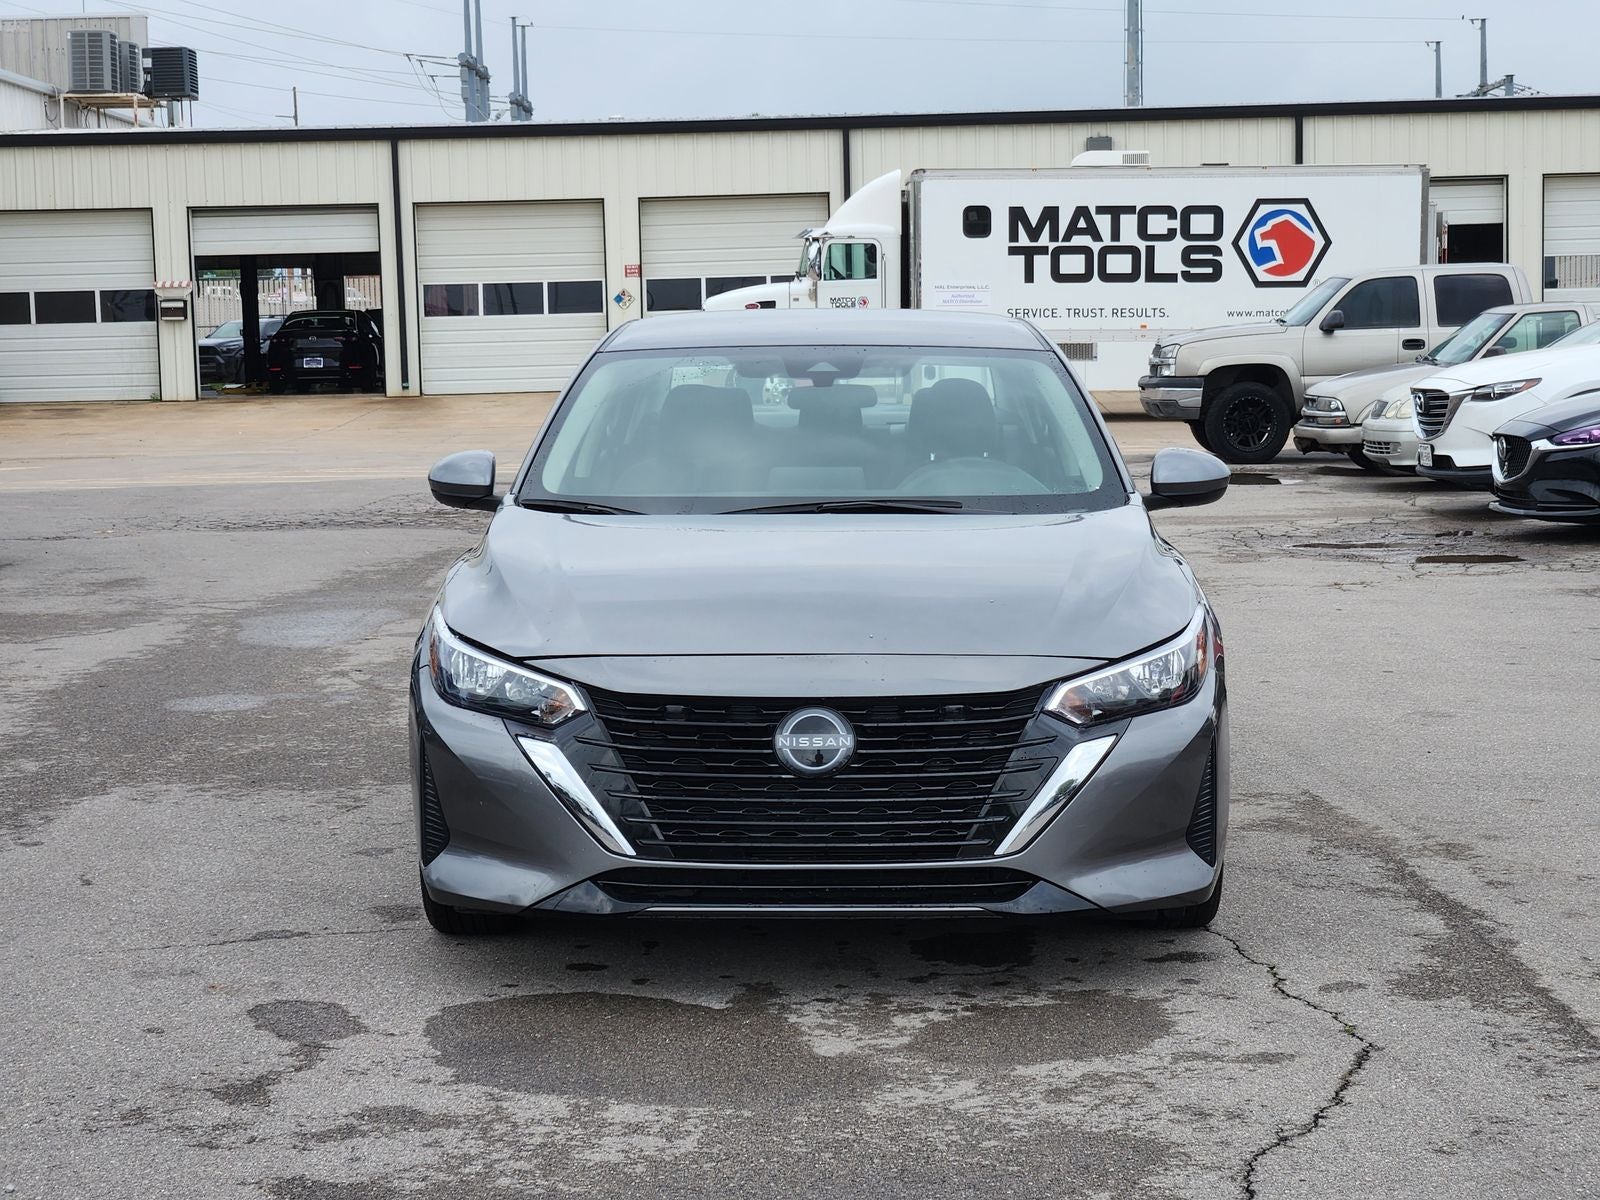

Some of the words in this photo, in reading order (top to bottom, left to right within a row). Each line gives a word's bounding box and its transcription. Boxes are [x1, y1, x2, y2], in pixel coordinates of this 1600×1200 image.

[1008, 205, 1224, 243] MATCO
[1007, 245, 1223, 283] TOOLS
[1007, 307, 1062, 318] SERVICE.
[1066, 307, 1108, 318] TRUST.
[1111, 307, 1170, 318] RESULTS.
[778, 736, 852, 747] NISSAN
